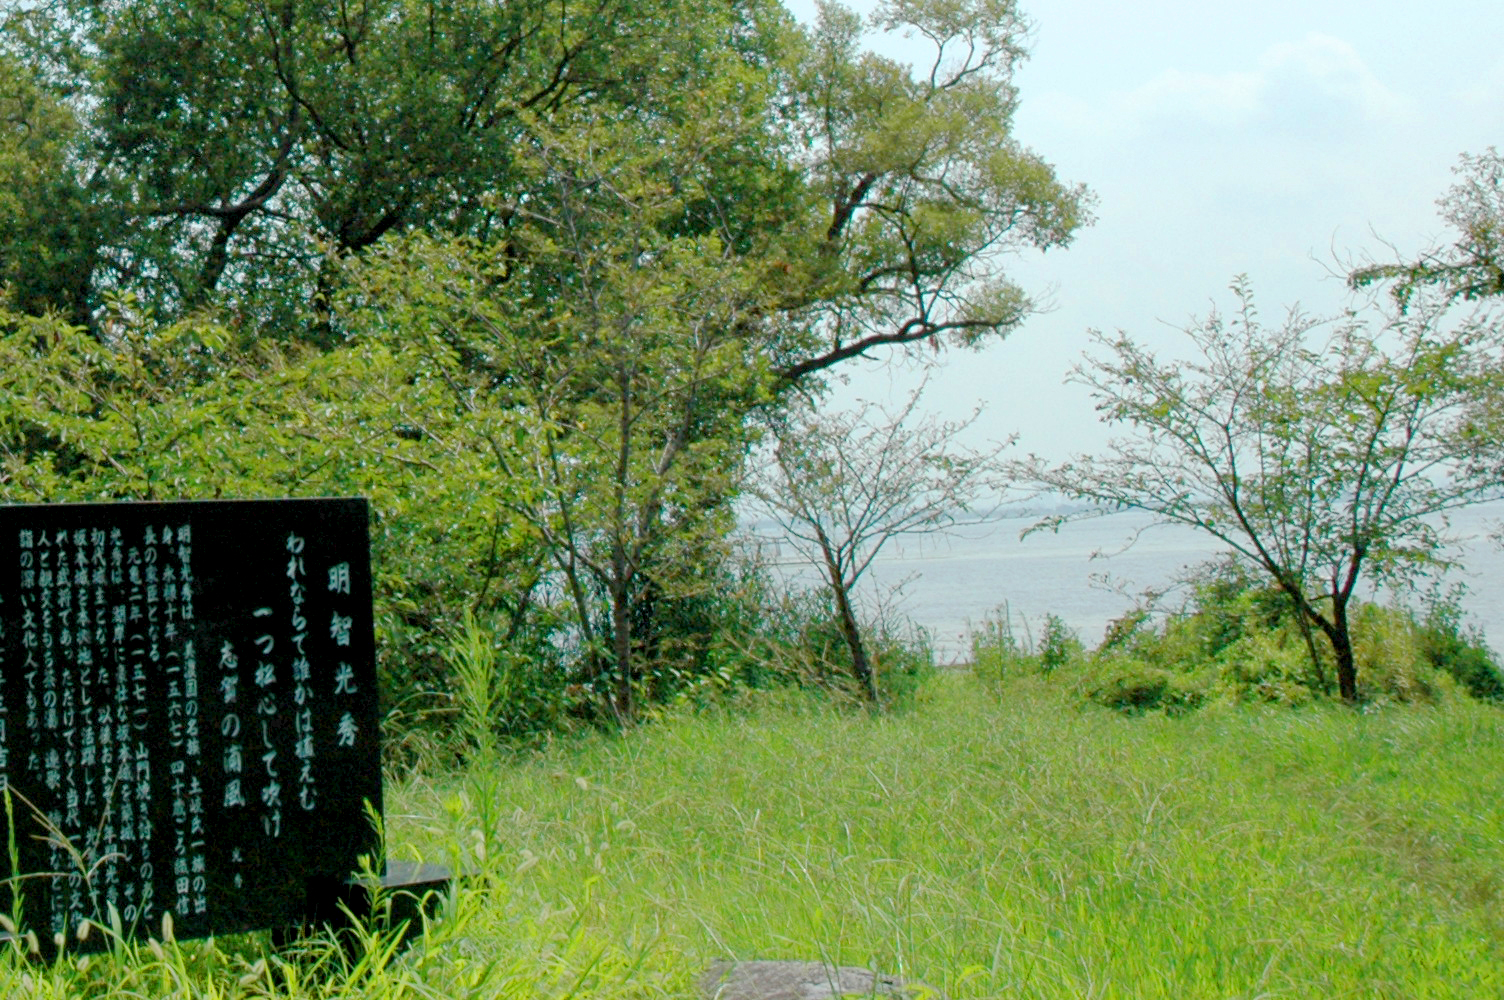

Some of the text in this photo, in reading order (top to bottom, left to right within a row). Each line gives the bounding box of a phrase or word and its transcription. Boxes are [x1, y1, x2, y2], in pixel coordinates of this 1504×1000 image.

[219, 640, 245, 807] 志賀の浦風
[328, 561, 360, 747] 明智光秀
